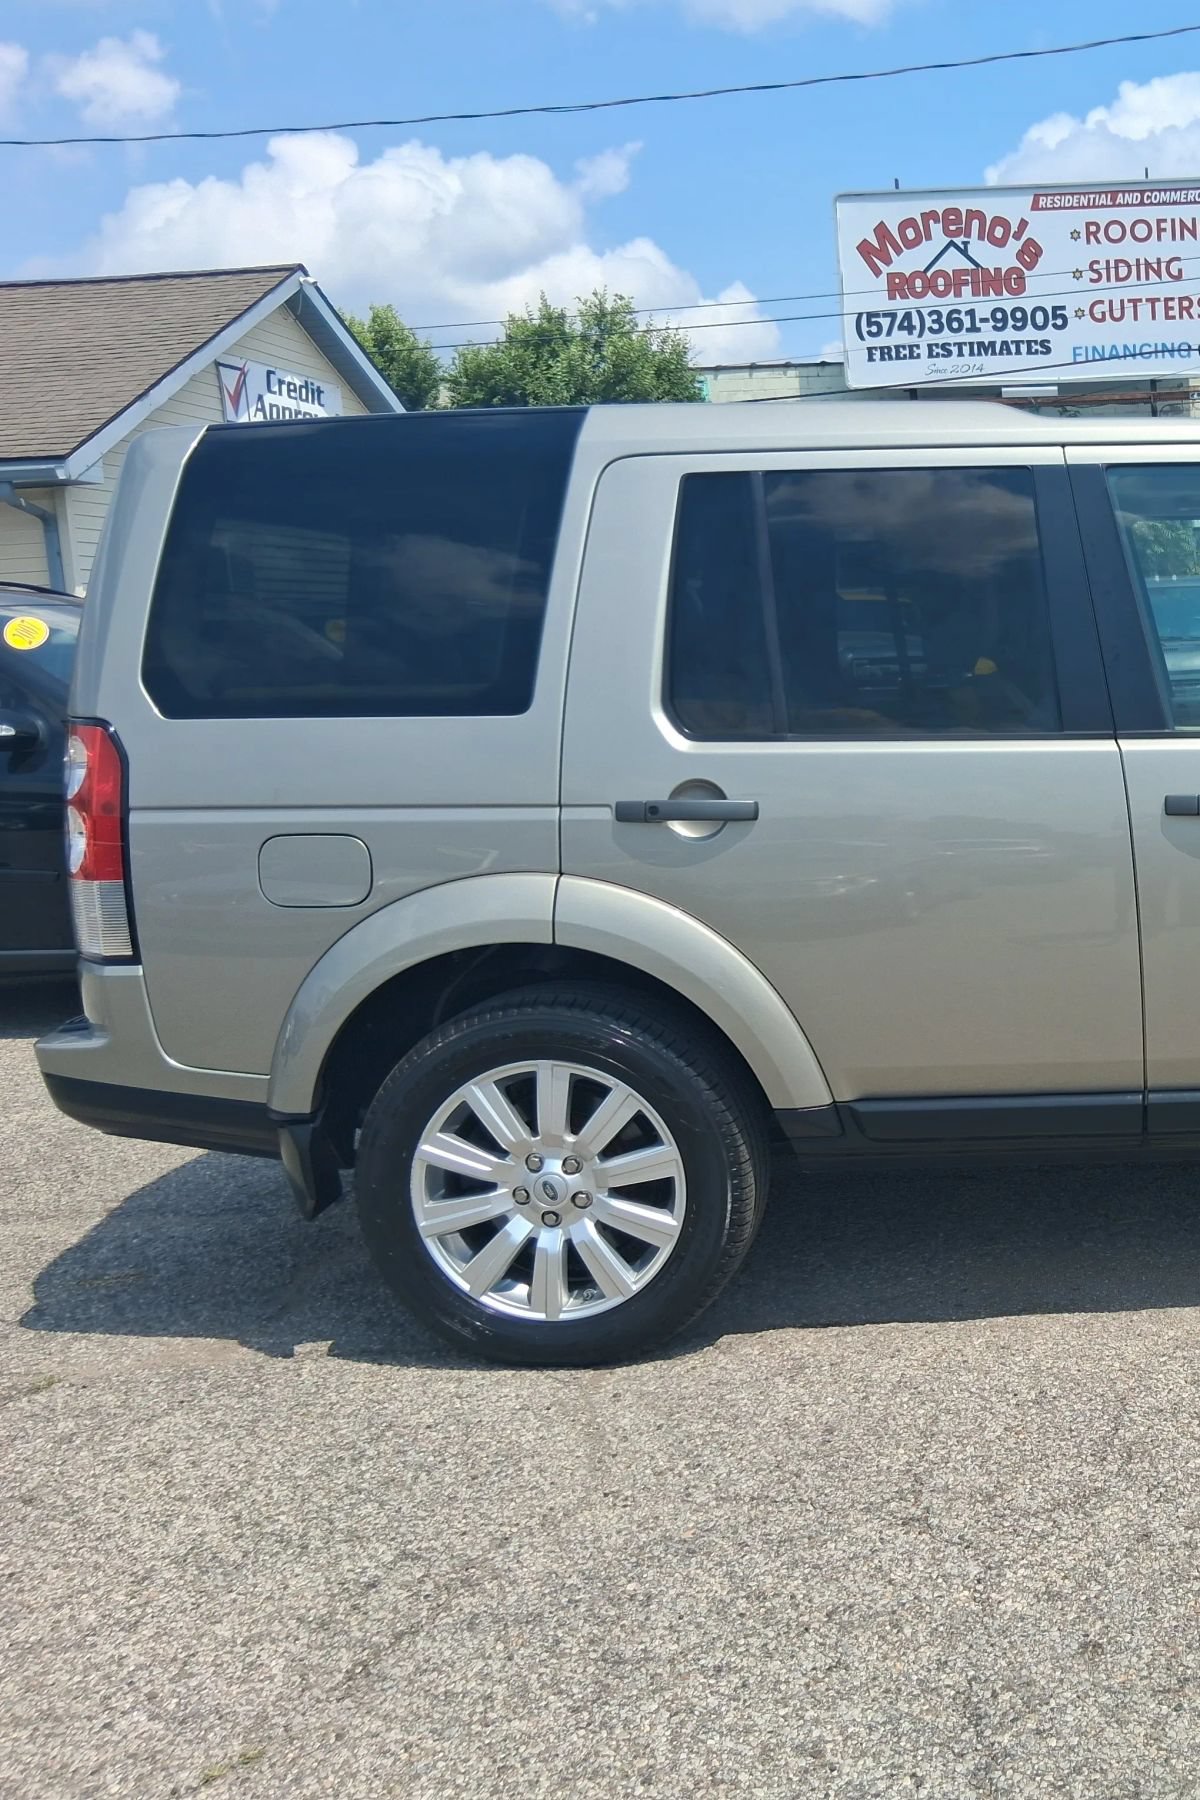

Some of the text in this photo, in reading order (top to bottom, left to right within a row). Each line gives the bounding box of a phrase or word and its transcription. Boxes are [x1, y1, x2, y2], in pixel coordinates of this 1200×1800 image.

[1039, 193, 1113, 208] RESIDENTIAL
[1116, 192, 1140, 205] AND
[856, 207, 1044, 279] Moreno's
[887, 266, 1027, 300] ROOFING
[1088, 257, 1183, 284] SIDING
[856, 305, 1069, 341] (574)361-9905
[866, 339, 1053, 362] FREE ESTIMATES
[950, 364, 985, 375] 2014
[266, 369, 325, 407] Credit
